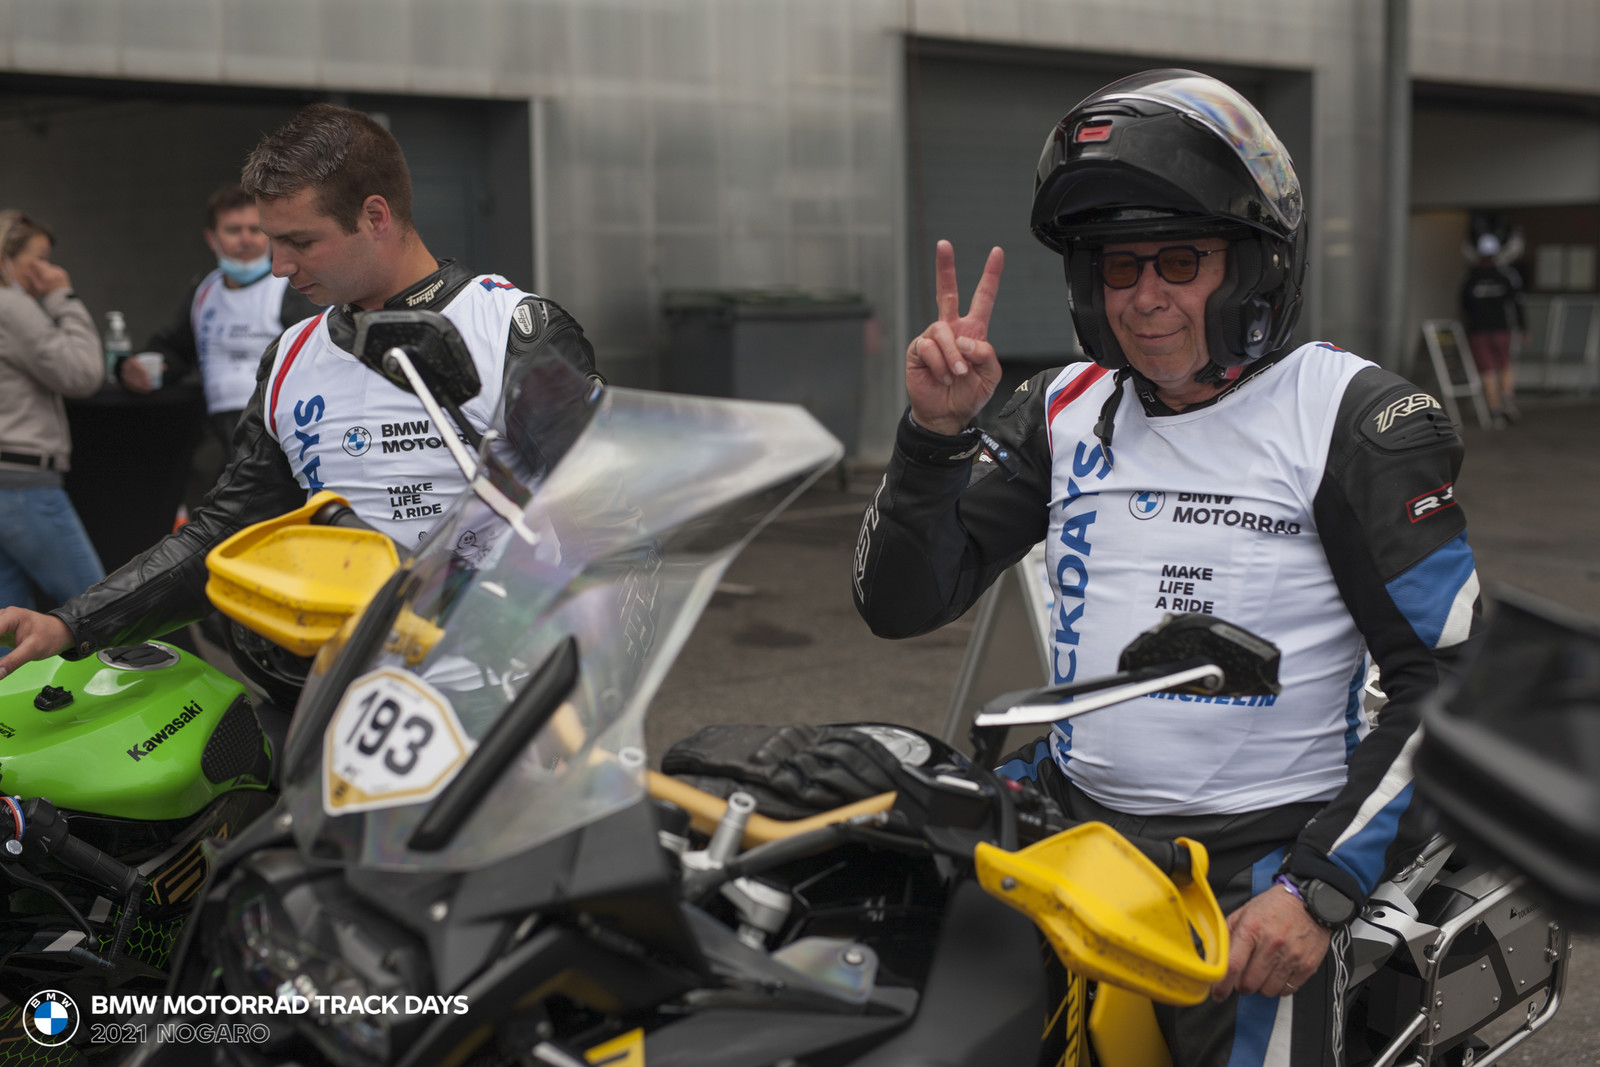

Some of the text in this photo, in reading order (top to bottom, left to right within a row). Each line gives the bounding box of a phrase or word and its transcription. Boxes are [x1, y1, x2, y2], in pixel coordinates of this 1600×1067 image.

[381, 419, 430, 438] BMW
[293, 394, 326, 495] AYS
[387, 482, 433, 495] MAKE
[390, 494, 422, 508] LIFE
[391, 503, 443, 520] A RIDE
[1172, 506, 1302, 535] MOTORRAD
[1161, 564, 1213, 581] MAKE
[1158, 580, 1195, 595] LIFE
[1155, 596, 1214, 614] A RIDE
[126, 699, 204, 762] Kawasaki
[345, 689, 435, 776] 193
